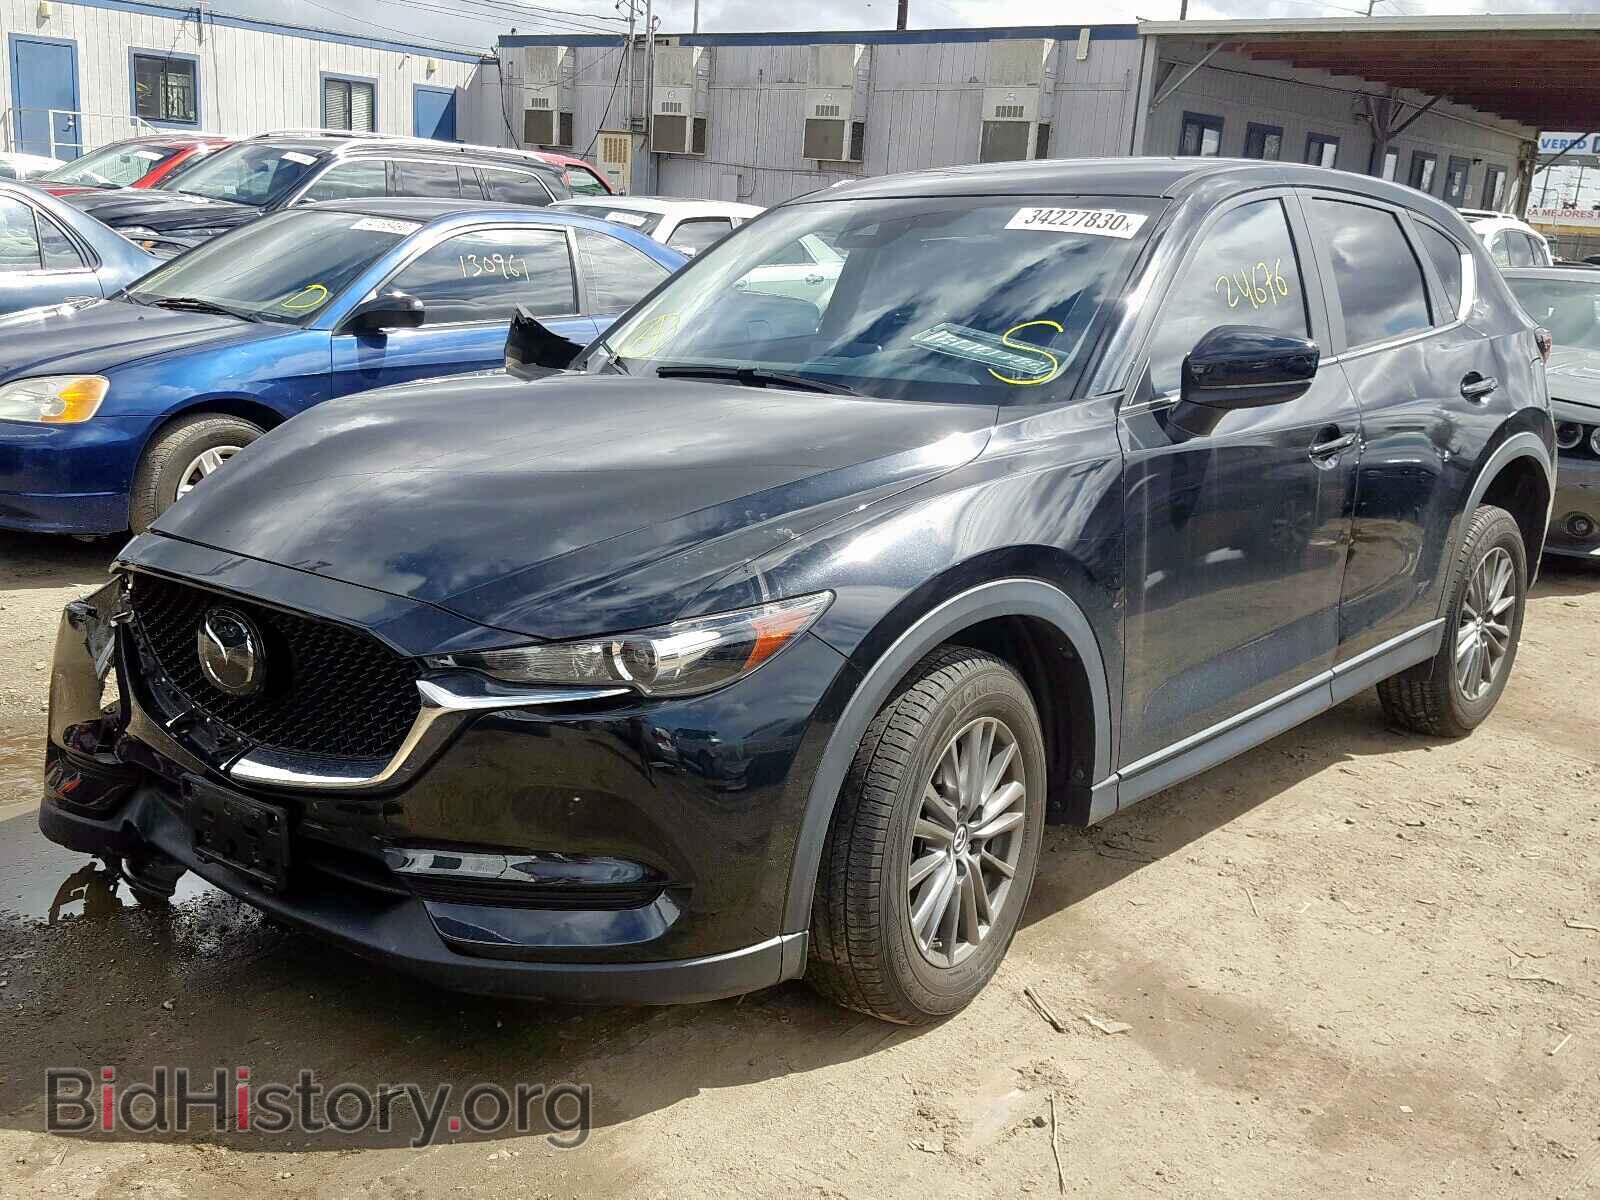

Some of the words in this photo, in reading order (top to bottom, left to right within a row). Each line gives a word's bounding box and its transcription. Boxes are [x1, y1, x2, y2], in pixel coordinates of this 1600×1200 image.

[1541, 208, 1594, 218] MEJORES
[1215, 258, 1288, 309] 24676
[987, 320, 1064, 385] S
